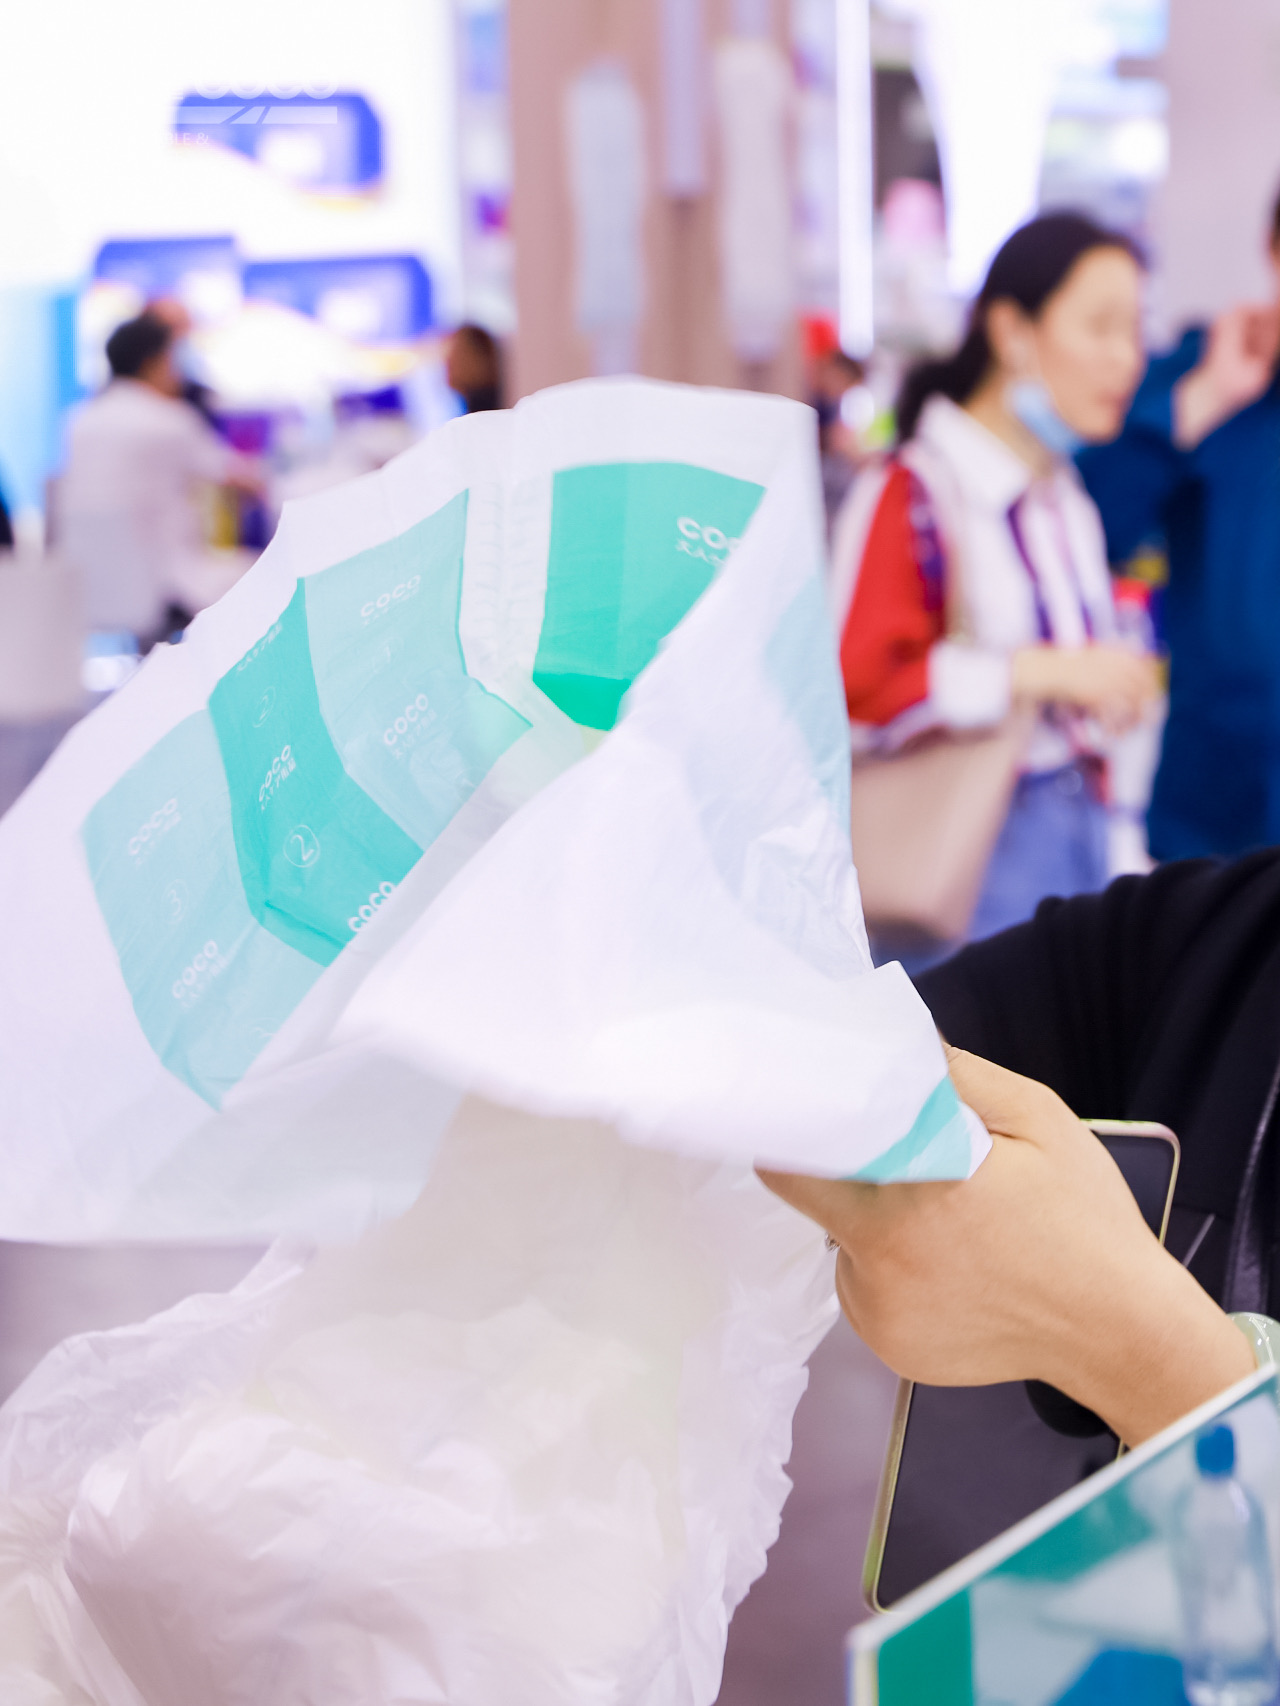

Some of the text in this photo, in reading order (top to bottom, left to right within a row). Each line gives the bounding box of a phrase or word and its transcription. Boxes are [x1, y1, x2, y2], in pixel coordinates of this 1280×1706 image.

[361, 574, 422, 617] COCO
[384, 693, 429, 746] COCO
[259, 745, 292, 802] COCO
[128, 798, 178, 855] COCO
[288, 831, 316, 864] 2
[348, 881, 394, 932] COCO
[172, 940, 218, 999] COCO
